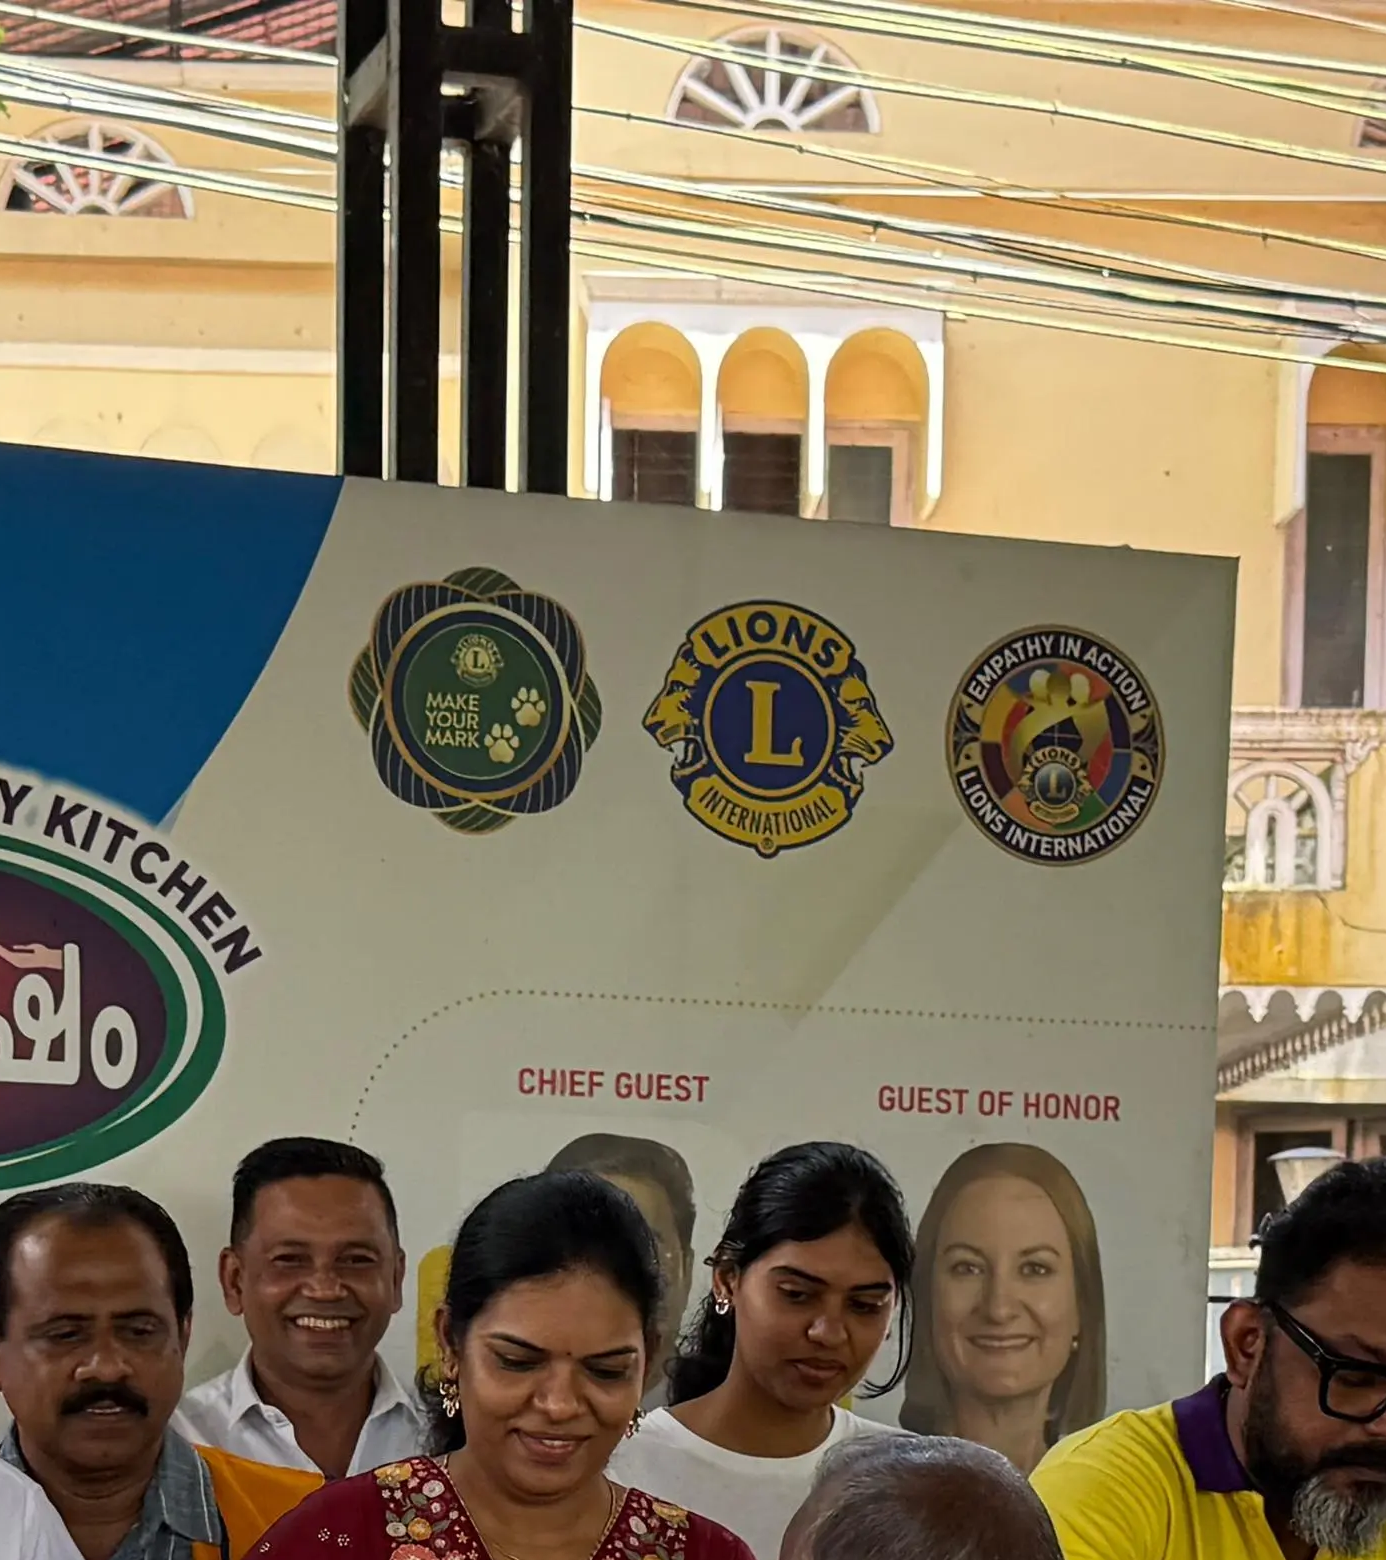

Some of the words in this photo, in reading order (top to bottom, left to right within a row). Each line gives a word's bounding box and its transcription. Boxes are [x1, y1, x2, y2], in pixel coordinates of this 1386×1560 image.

[701, 611, 844, 669] LIONS
[968, 635, 1056, 702] EMPATHY
[1060, 635, 1081, 658] IN
[1084, 646, 1147, 712] ACTION
[424, 711, 479, 729] YOUR
[425, 692, 480, 712] MAKE
[744, 680, 804, 767] L
[424, 730, 480, 748] MARK
[699, 786, 838, 836] INTERNATIONAL
[958, 771, 1008, 834] LIONS
[1005, 782, 1152, 857] INTERNATIONAL
[44, 794, 263, 975] KITCHEN
[517, 1067, 604, 1099] CHIEF
[613, 1071, 710, 1103] GUEST
[878, 1085, 970, 1116] GUEST
[977, 1090, 1014, 1117] OF
[1023, 1092, 1121, 1121] HONOR
